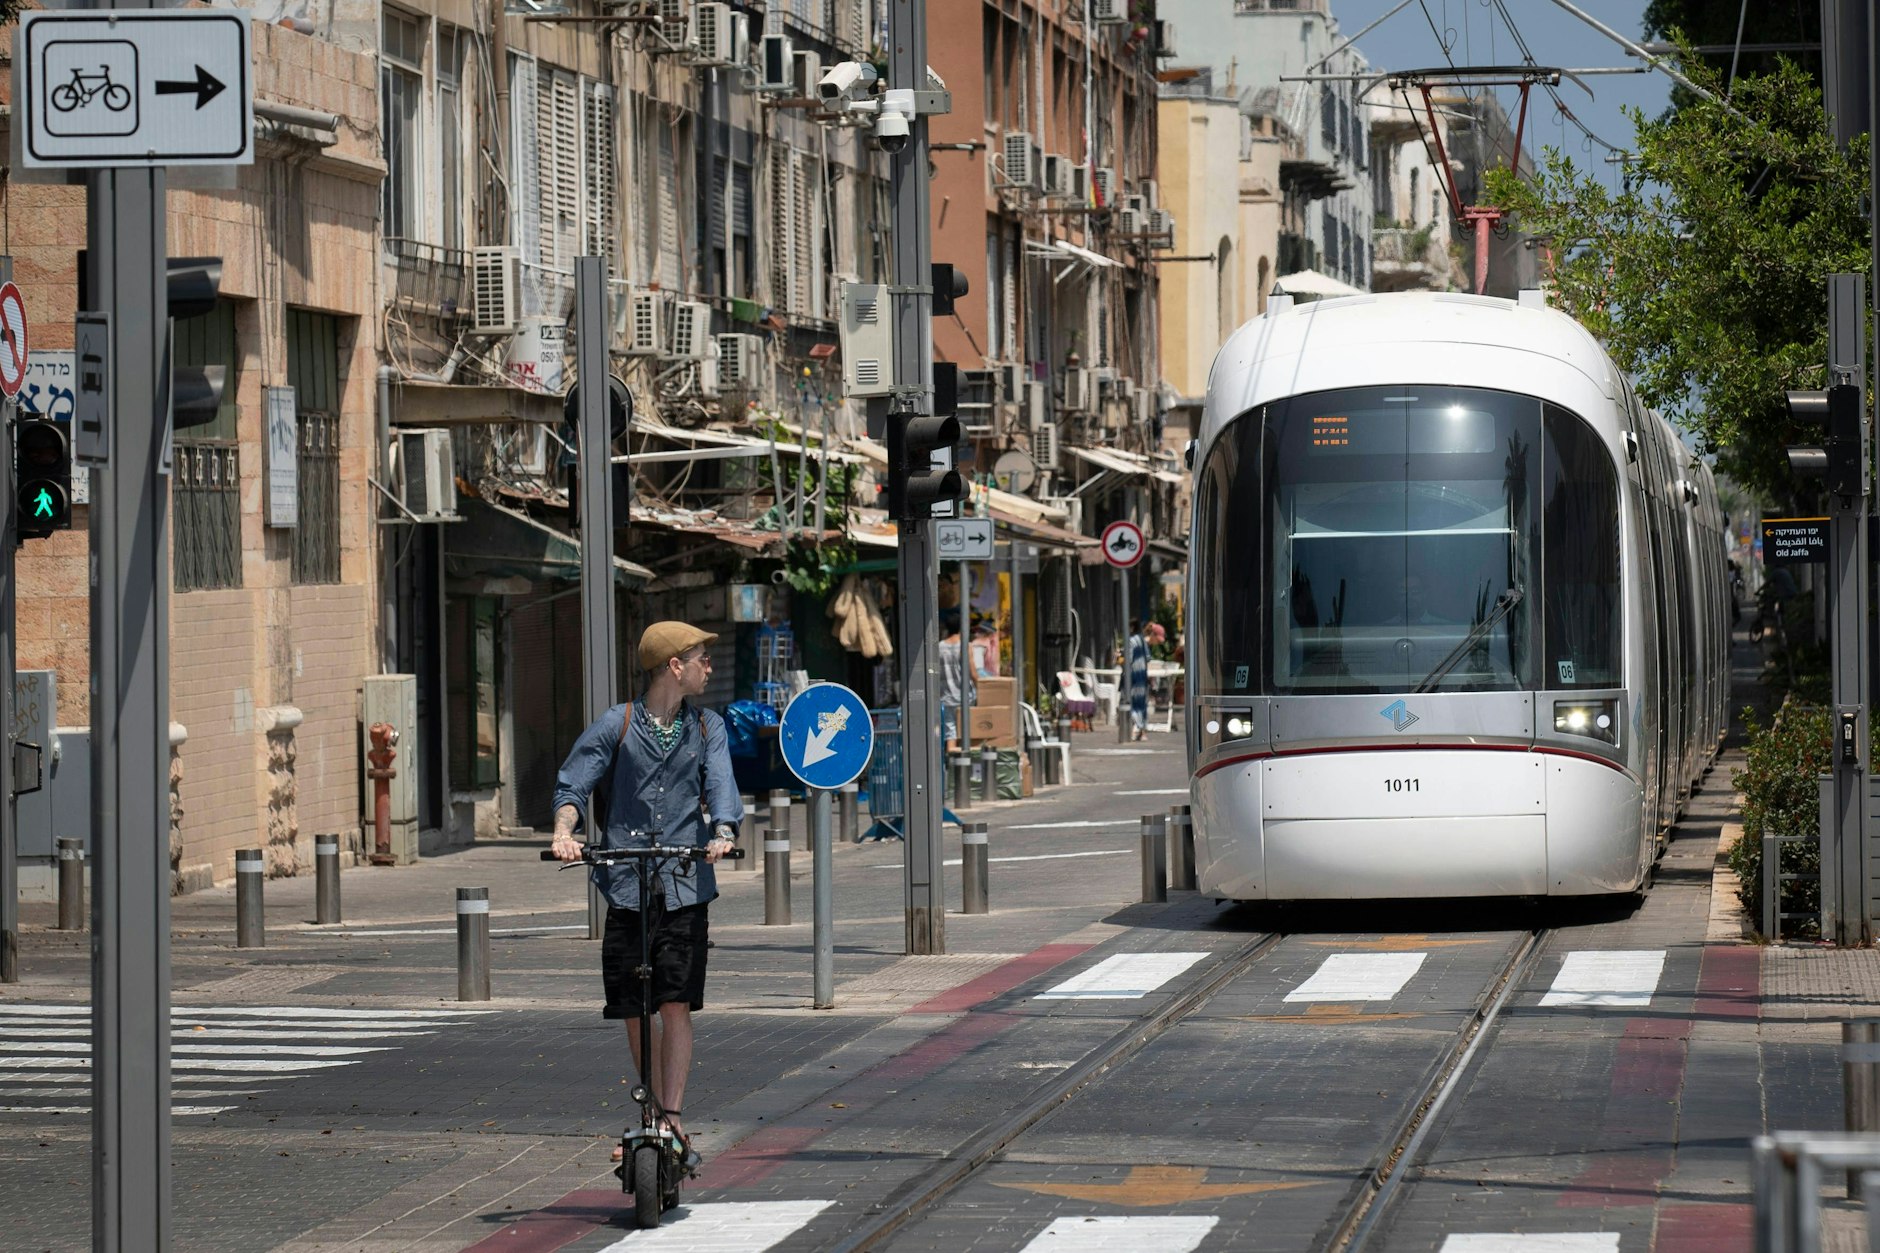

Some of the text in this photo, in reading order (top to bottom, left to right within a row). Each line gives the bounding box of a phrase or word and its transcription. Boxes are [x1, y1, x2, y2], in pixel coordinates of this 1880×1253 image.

[1775, 528, 1806, 537] העתיקה
[1775, 537, 1824, 547] يافا القديمة
[1775, 548, 1809, 557] Old Jaffa
[1236, 670, 1247, 684] 06
[1561, 665, 1573, 679] 06
[1384, 778, 1419, 792] 1011
